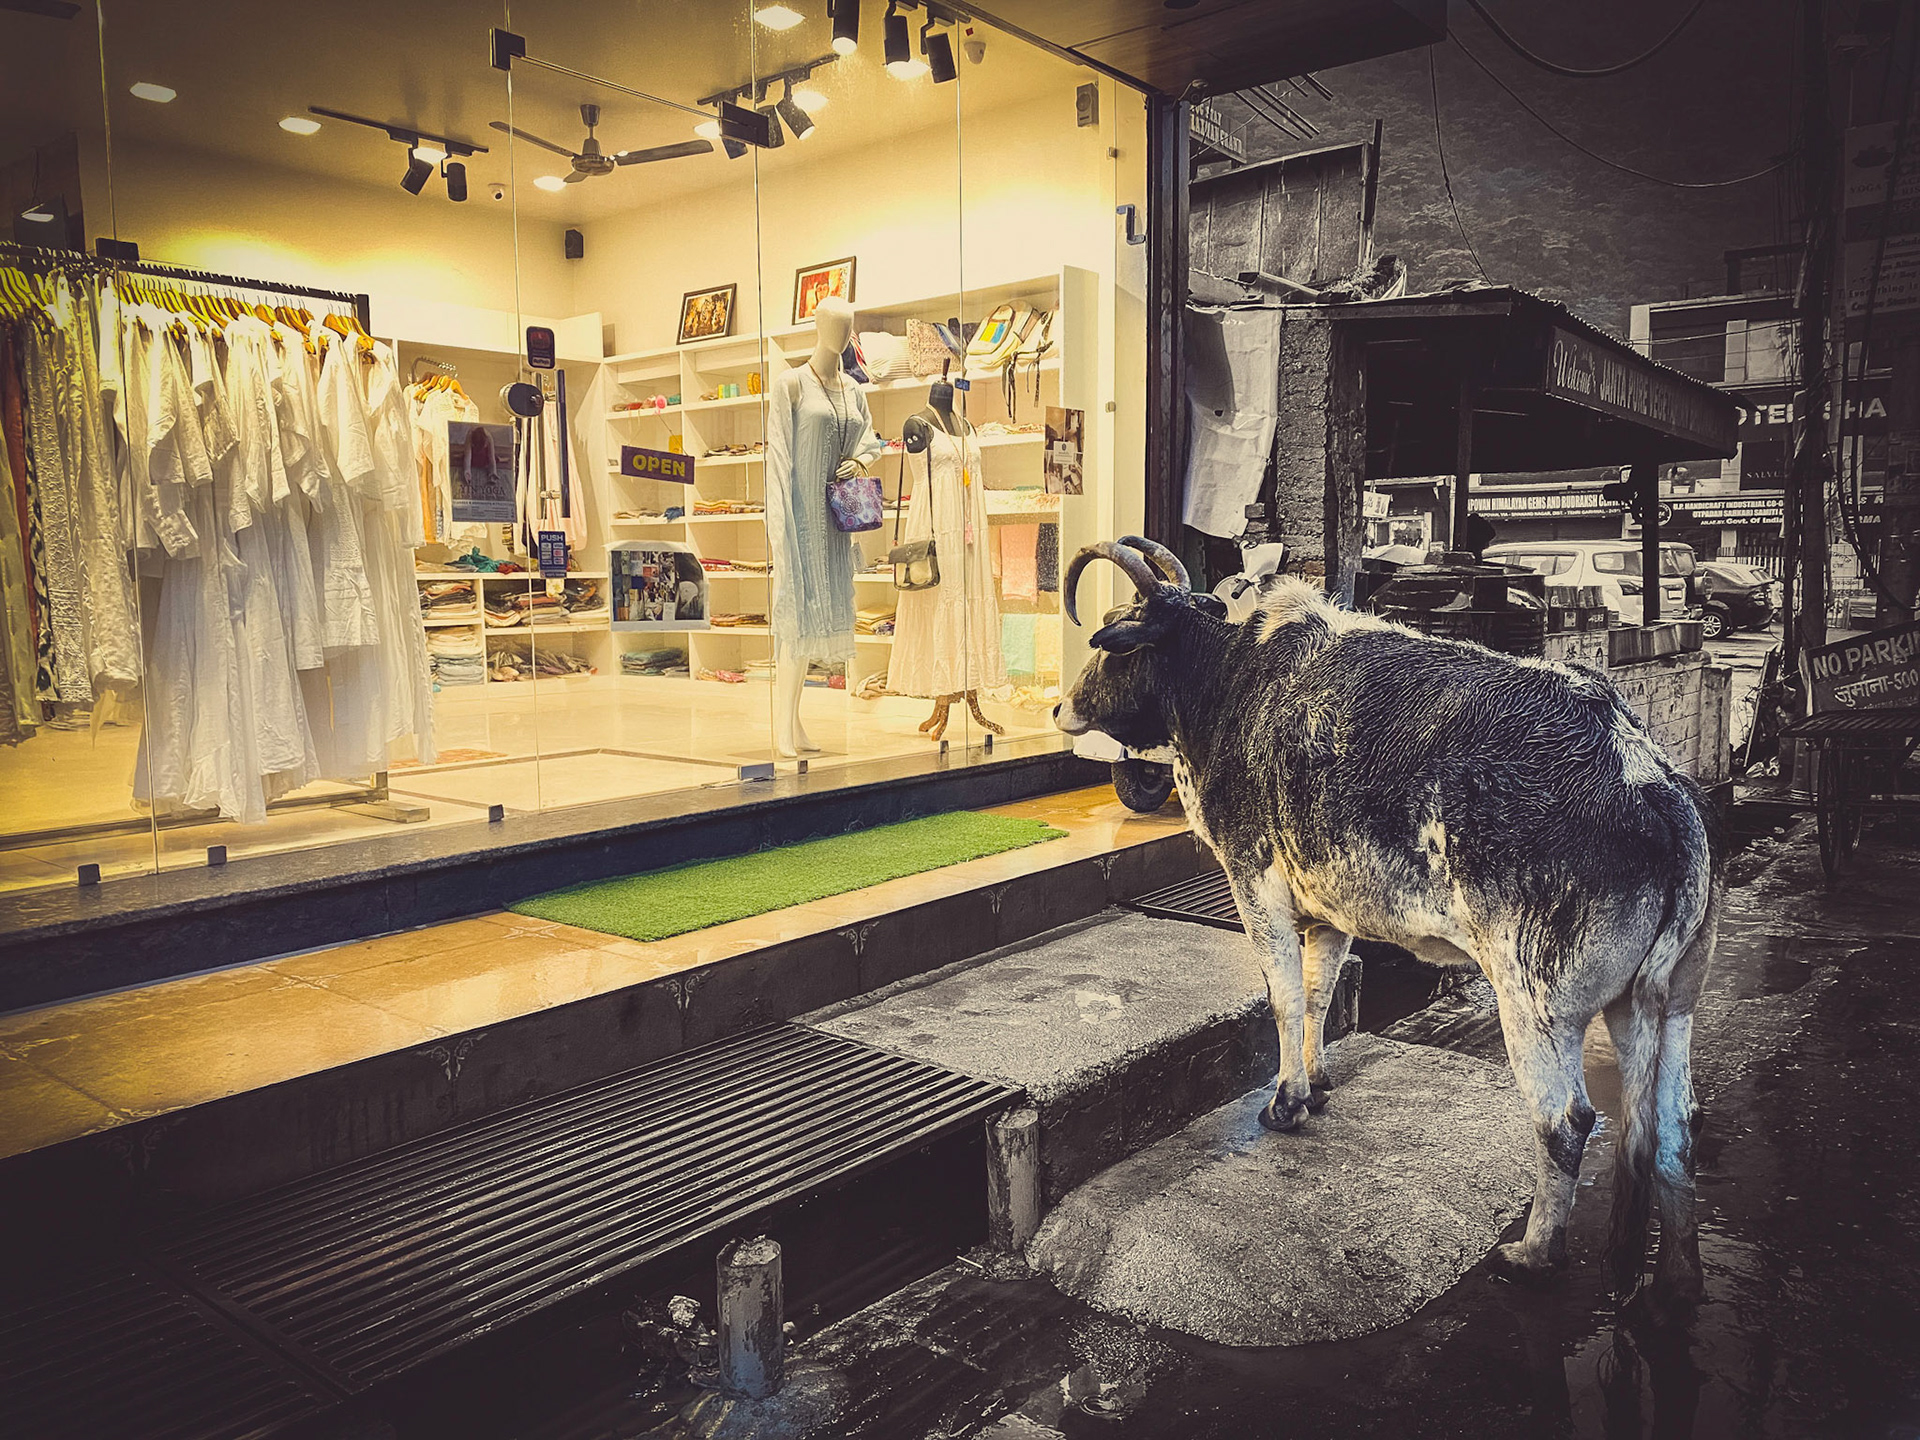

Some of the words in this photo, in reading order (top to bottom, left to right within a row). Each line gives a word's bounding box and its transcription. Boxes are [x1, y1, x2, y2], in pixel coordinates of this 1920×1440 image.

[1849, 284, 1905, 298] Everthing
[1552, 340, 1592, 396] Welcome
[1599, 357, 1626, 408] JANTA
[1626, 366, 1648, 416] PURE
[1734, 403, 1795, 426] OTEL
[632, 454, 686, 478] OPEN
[459, 484, 478, 495] YIN
[480, 484, 507, 496] YOGA
[1492, 497, 1527, 510] HIMALAYAN
[1528, 496, 1546, 509] GEMS
[1547, 496, 1560, 508] AND
[1561, 494, 1598, 508] RUDRAKSH
[1685, 502, 1725, 511] HANDICRAFT
[1726, 500, 1766, 509] INDUSTRIAL
[1726, 517, 1749, 525] Govt.
[541, 533, 564, 542] PUSH
[1813, 652, 1842, 681] NO
